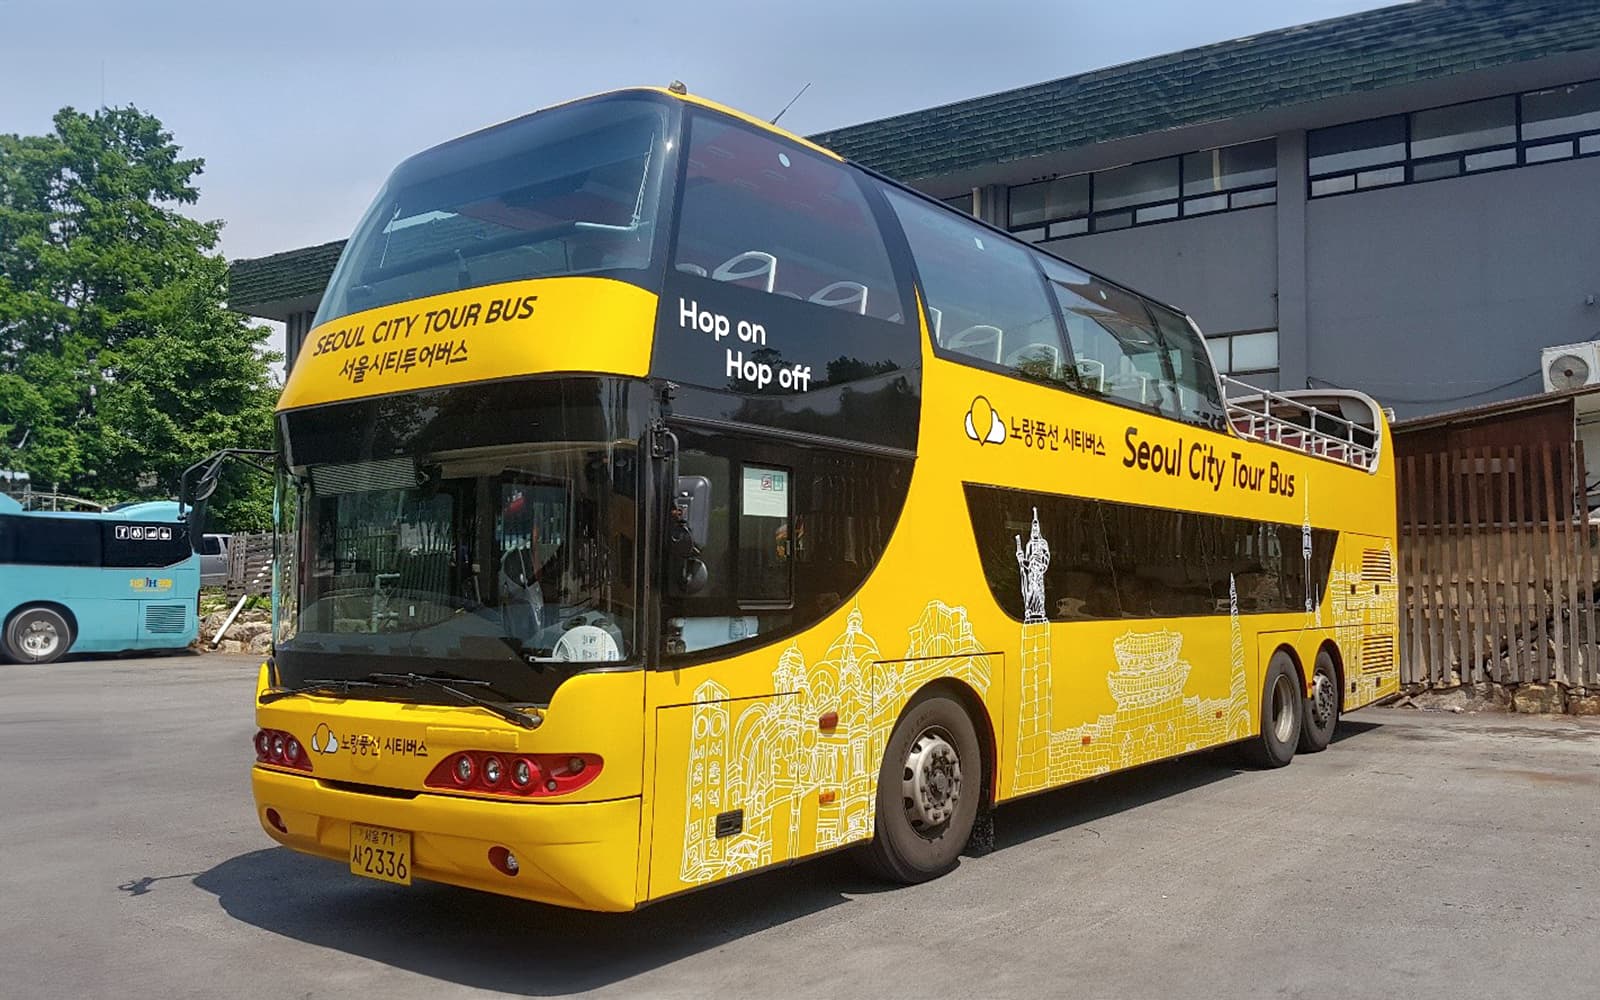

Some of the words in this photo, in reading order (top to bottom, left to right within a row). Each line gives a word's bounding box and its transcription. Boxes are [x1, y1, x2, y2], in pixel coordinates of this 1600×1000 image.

[312, 325, 365, 356] SEOUL
[371, 314, 420, 344] CITY
[424, 303, 482, 334] TOUR
[485, 295, 538, 324] BUS
[679, 298, 730, 342] Hop
[737, 320, 766, 346] on
[339, 338, 468, 383] 서울시티투어버스
[728, 348, 773, 388] Hop
[779, 364, 811, 391] off
[1009, 416, 1059, 452] 노랑풍선
[1063, 428, 1106, 457] 시티버스
[1122, 426, 1183, 478] Seoul
[1188, 442, 1226, 492] City
[1230, 452, 1266, 492] Tour
[1269, 461, 1296, 498] Bus
[341, 733, 381, 756] 노랑풍선
[384, 737, 429, 757] 시티버스
